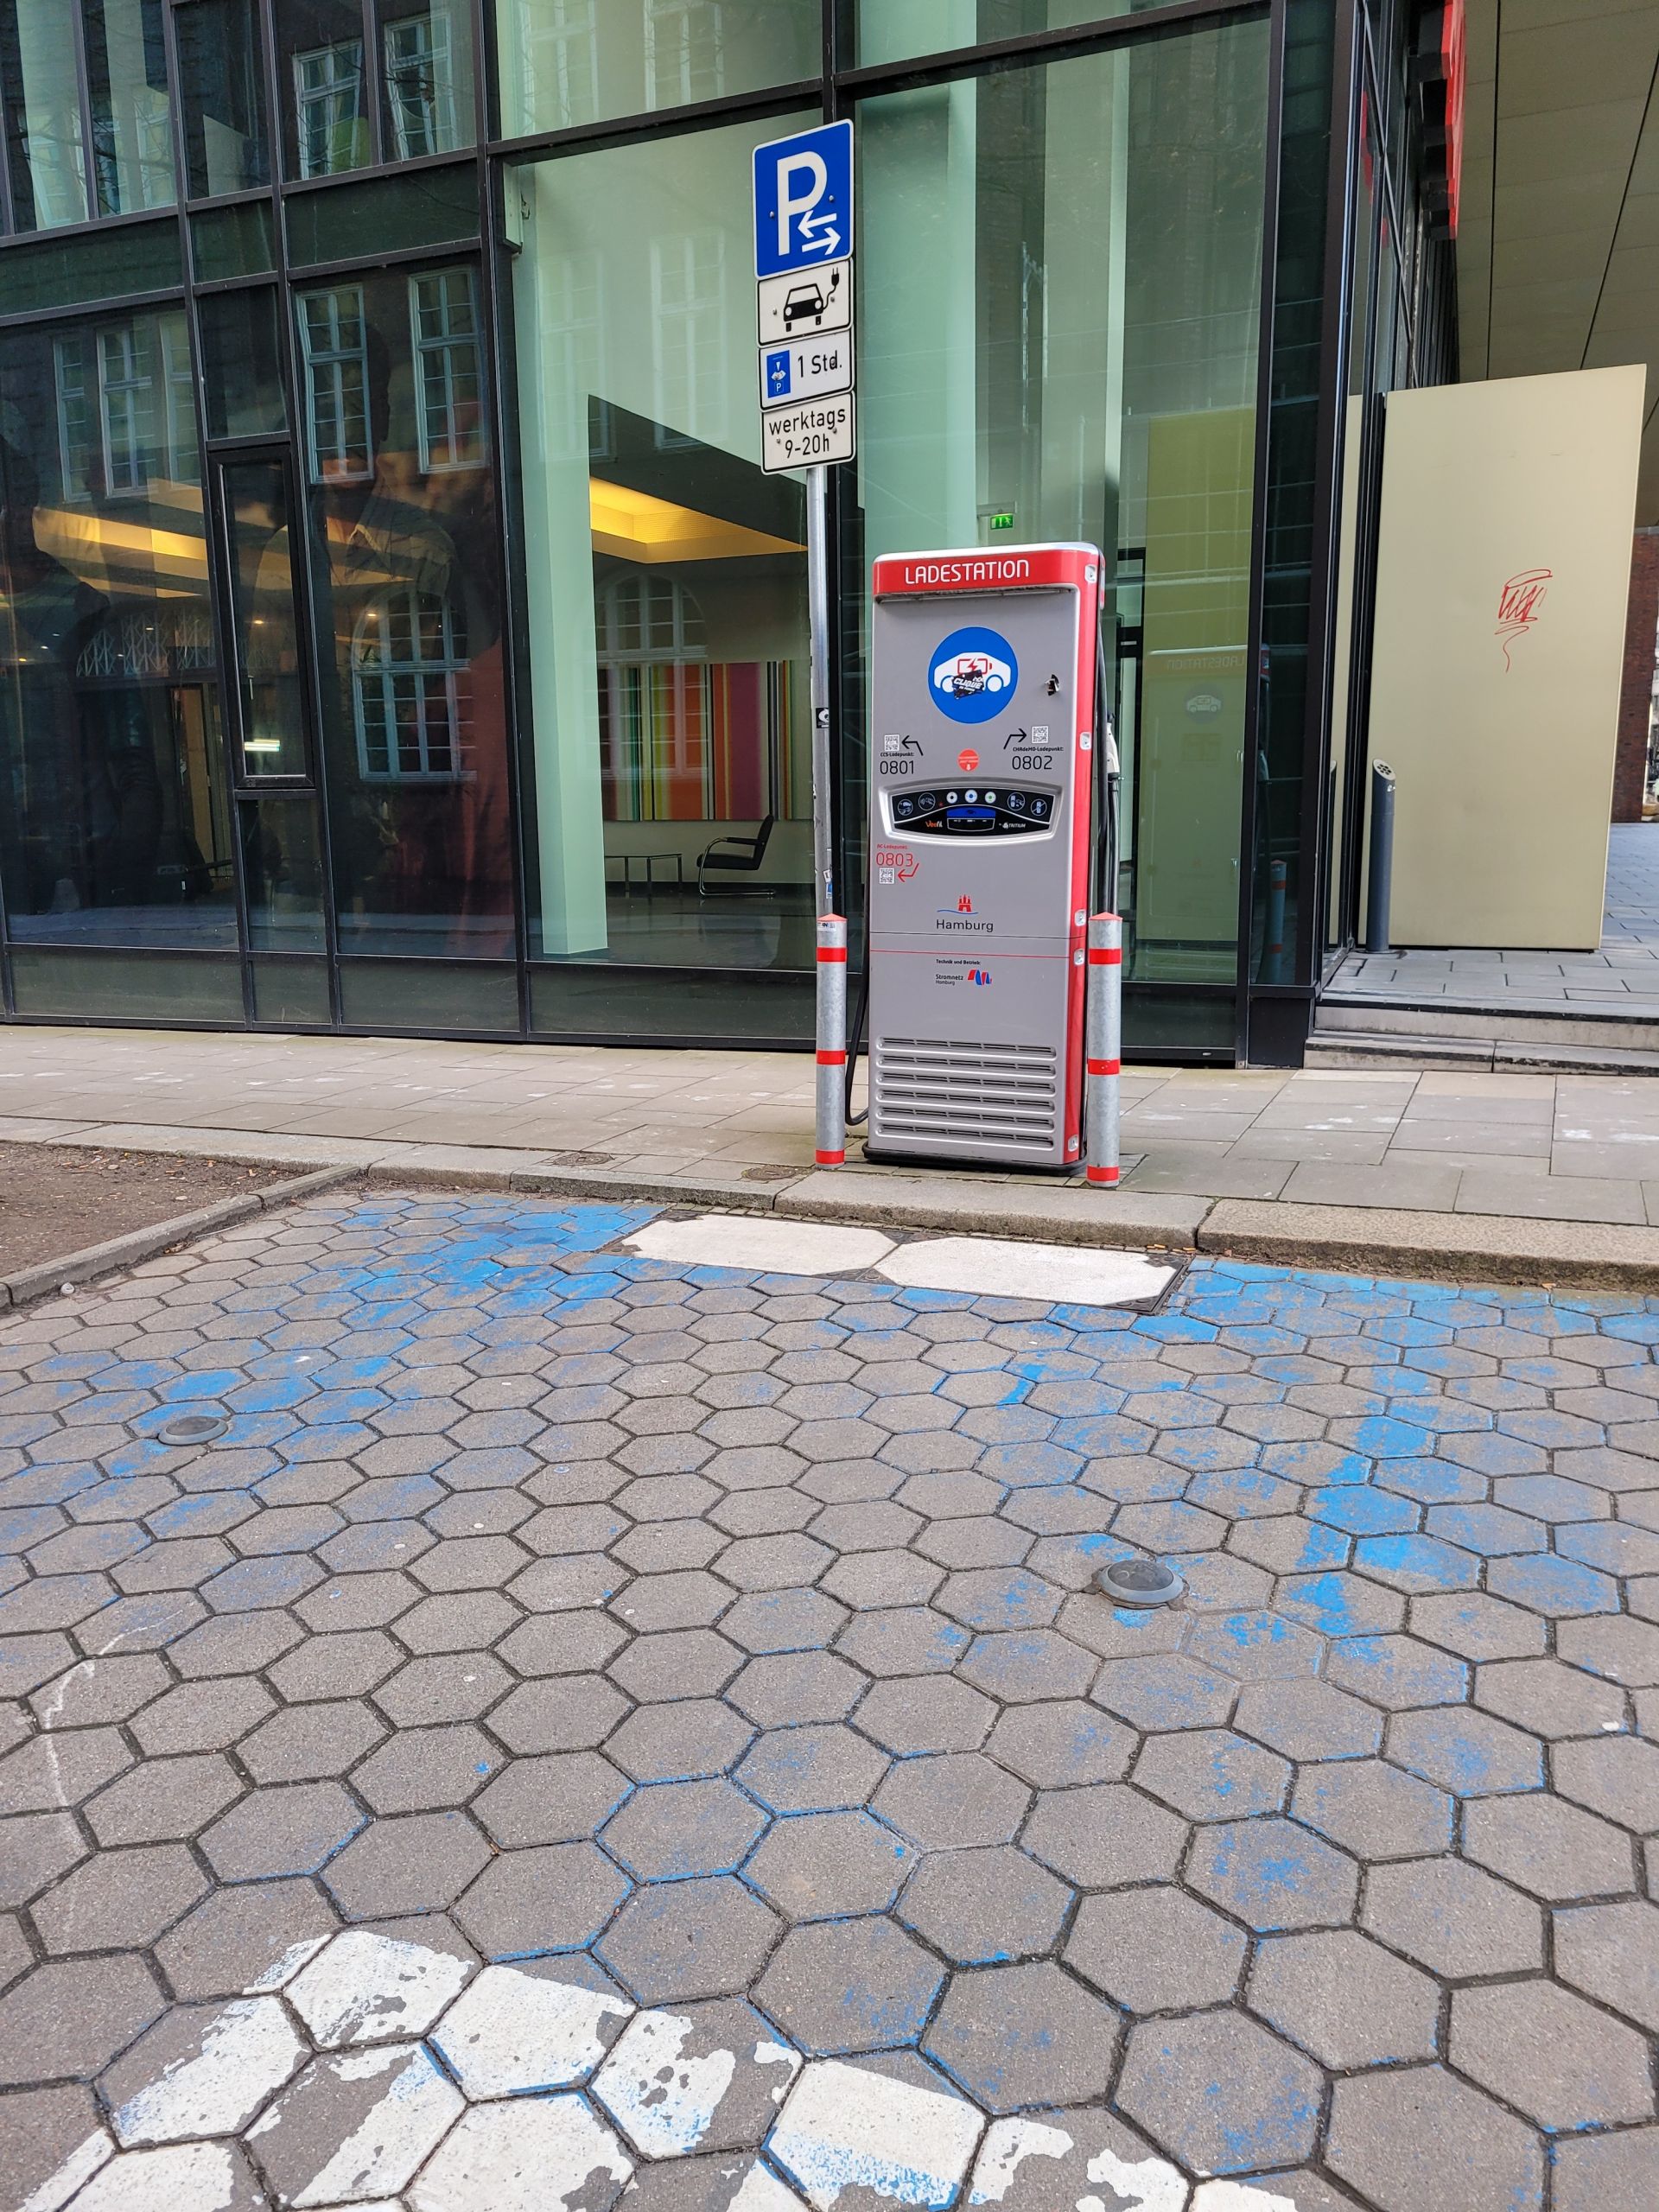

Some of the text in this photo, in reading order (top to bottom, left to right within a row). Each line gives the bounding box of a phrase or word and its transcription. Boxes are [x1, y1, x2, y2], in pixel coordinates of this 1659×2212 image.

[777, 150, 828, 256] P
[798, 350, 842, 378] 1 Std.
[769, 407, 846, 436] werktags
[785, 434, 830, 459] 9-20h
[905, 559, 1030, 585] LADESTATION
[880, 760, 914, 775] 0801
[1012, 755, 1052, 770] 0802
[876, 852, 913, 868] 0803
[936, 918, 994, 933] Hamburg
